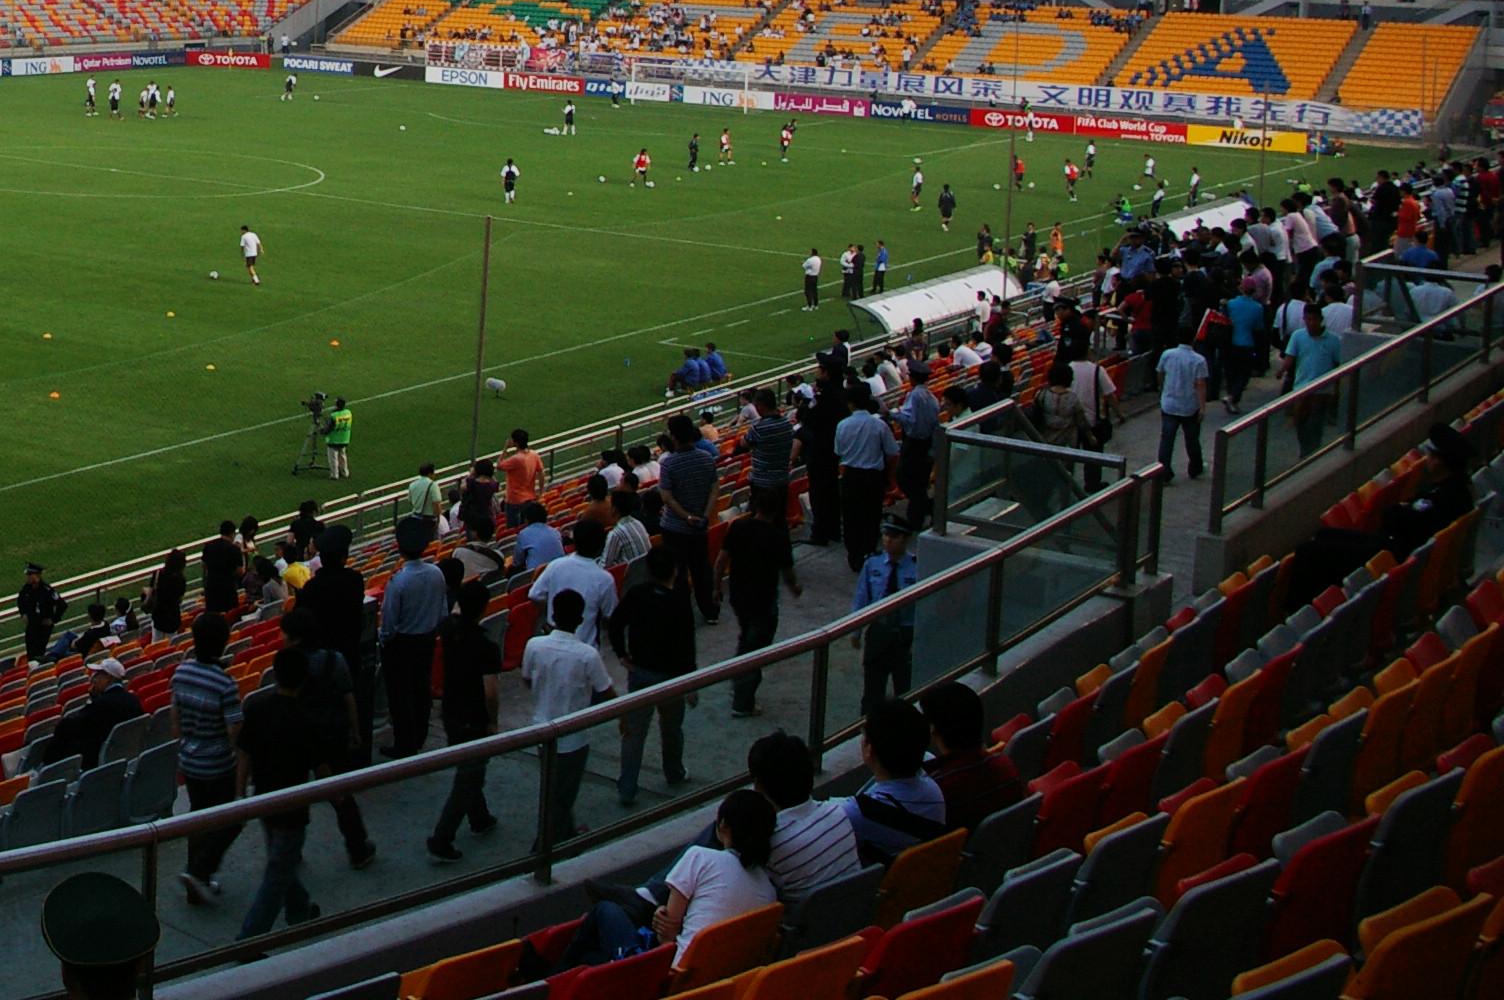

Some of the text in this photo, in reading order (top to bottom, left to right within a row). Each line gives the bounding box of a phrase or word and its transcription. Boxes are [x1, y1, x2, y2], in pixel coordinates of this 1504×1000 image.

[25, 61, 47, 74] ING
[133, 55, 167, 66] NOVOTEL
[216, 55, 258, 66] TOYOTA
[284, 57, 353, 73] POCARI SWEAT
[442, 70, 488, 85] EPSON
[508, 73, 580, 92] Fly Emirates
[754, 62, 1002, 99] 天津力展风采
[702, 91, 735, 107] ING
[871, 104, 934, 120] NOVTEL
[1077, 116, 1167, 135] FIFA Club World Cup
[1150, 133, 1186, 143] TOYOTA
[1219, 129, 1273, 148] Nikon
